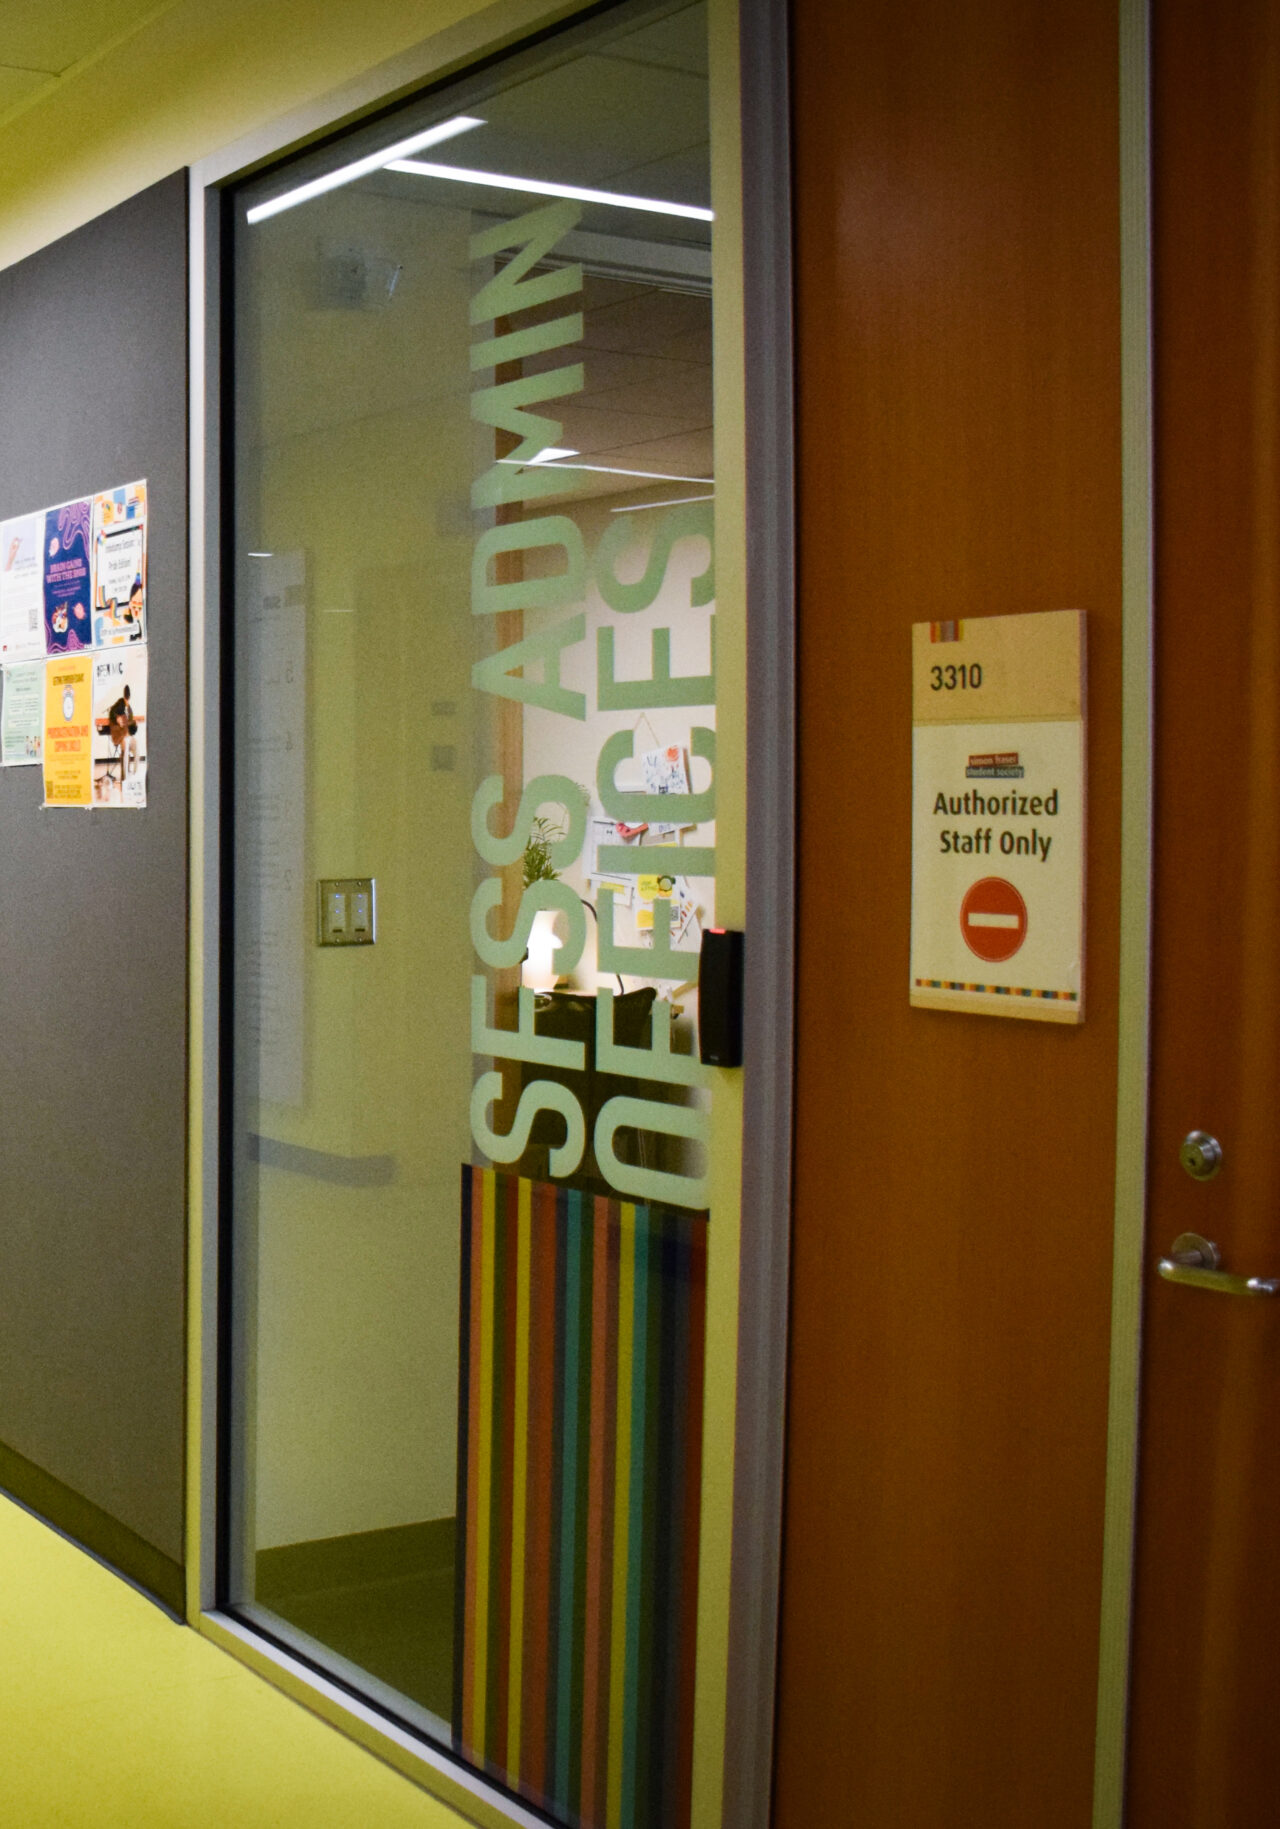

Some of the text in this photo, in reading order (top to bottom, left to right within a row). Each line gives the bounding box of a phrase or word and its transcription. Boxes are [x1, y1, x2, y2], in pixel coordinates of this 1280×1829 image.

[470, 201, 587, 1178] SFSS ADMIN
[930, 663, 983, 692] 3310
[966, 767, 995, 777] student
[971, 754, 1017, 767] simon fraser
[933, 788, 1059, 817] Authorized
[594, 499, 716, 1209] OFFICES
[939, 828, 1052, 862] Staff Only
